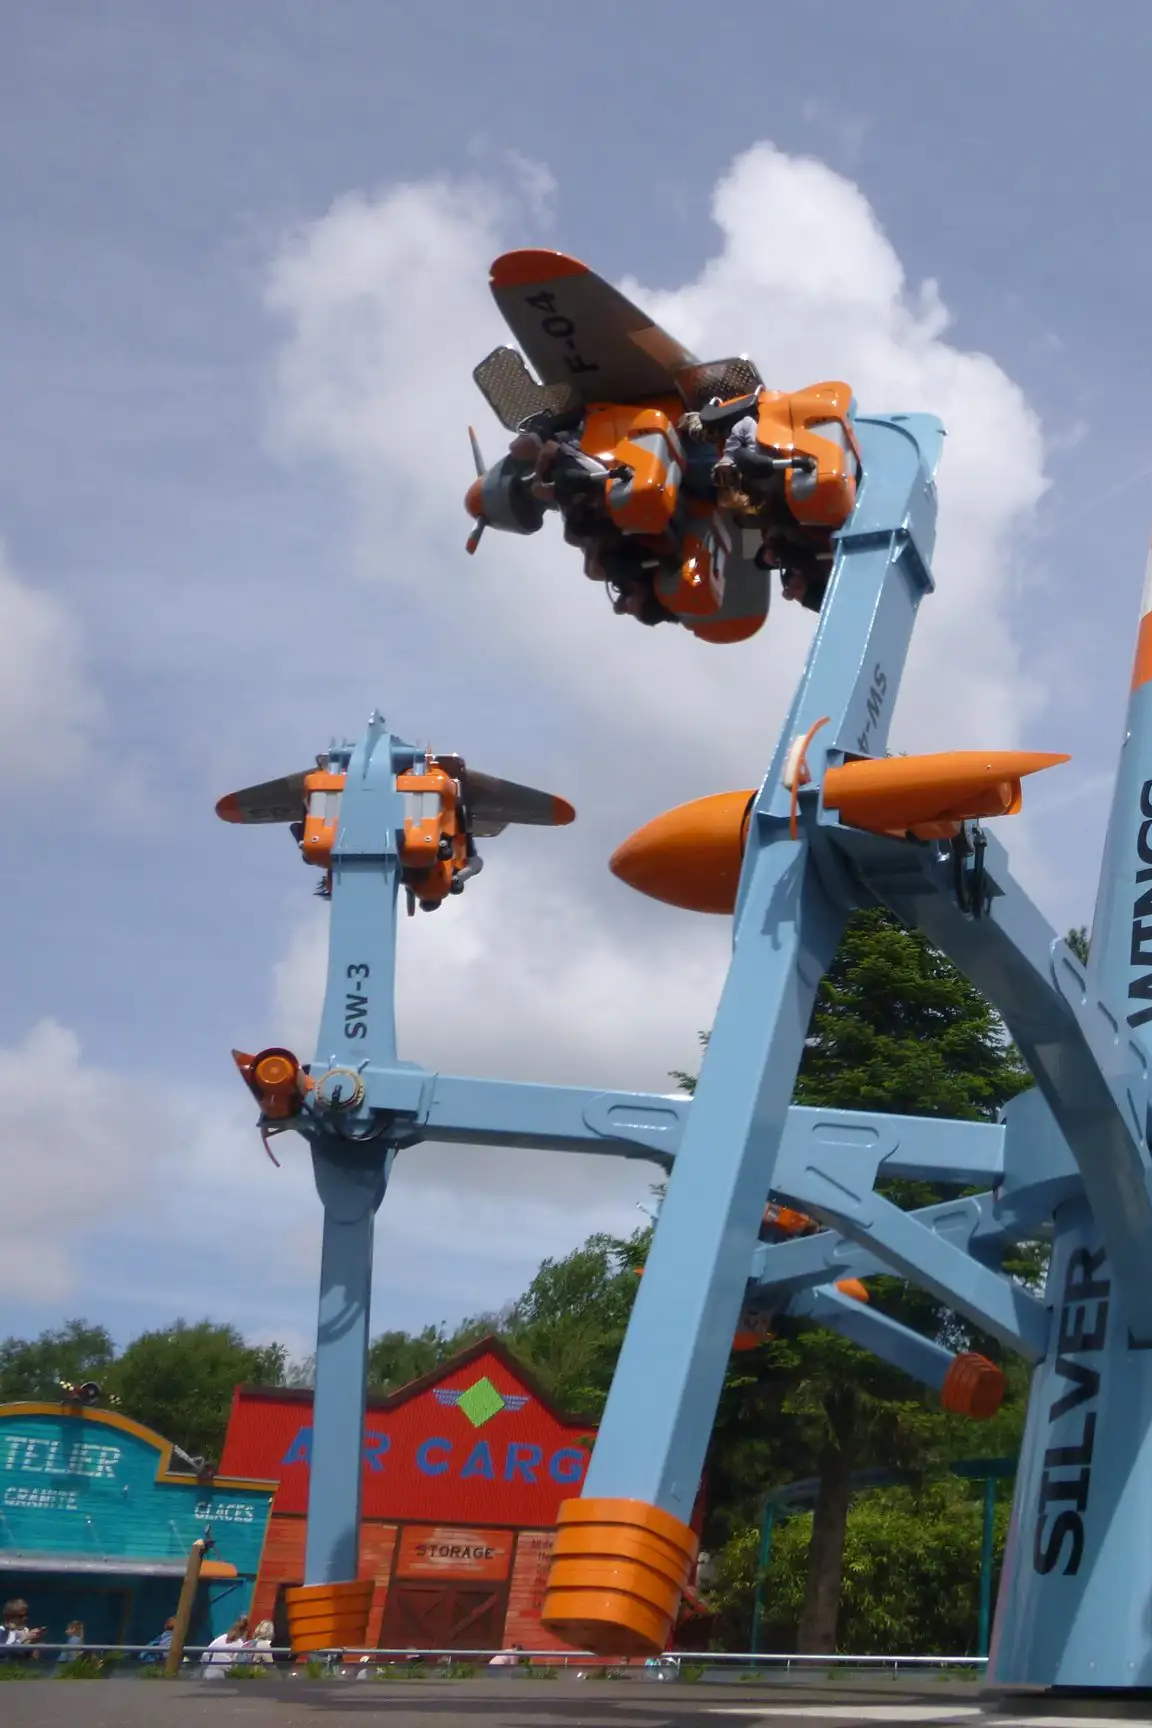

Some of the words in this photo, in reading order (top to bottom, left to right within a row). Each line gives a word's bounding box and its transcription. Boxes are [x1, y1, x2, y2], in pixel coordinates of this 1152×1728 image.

[525, 291, 600, 374] F-04
[344, 963, 370, 1040] SW-3
[1033, 1246, 1111, 1576] SILVER
[4, 1436, 121, 1479] TELIER
[282, 1426, 391, 1472] AR
[416, 1436, 584, 1484] CARG
[416, 1544, 496, 1560] STORAGE
